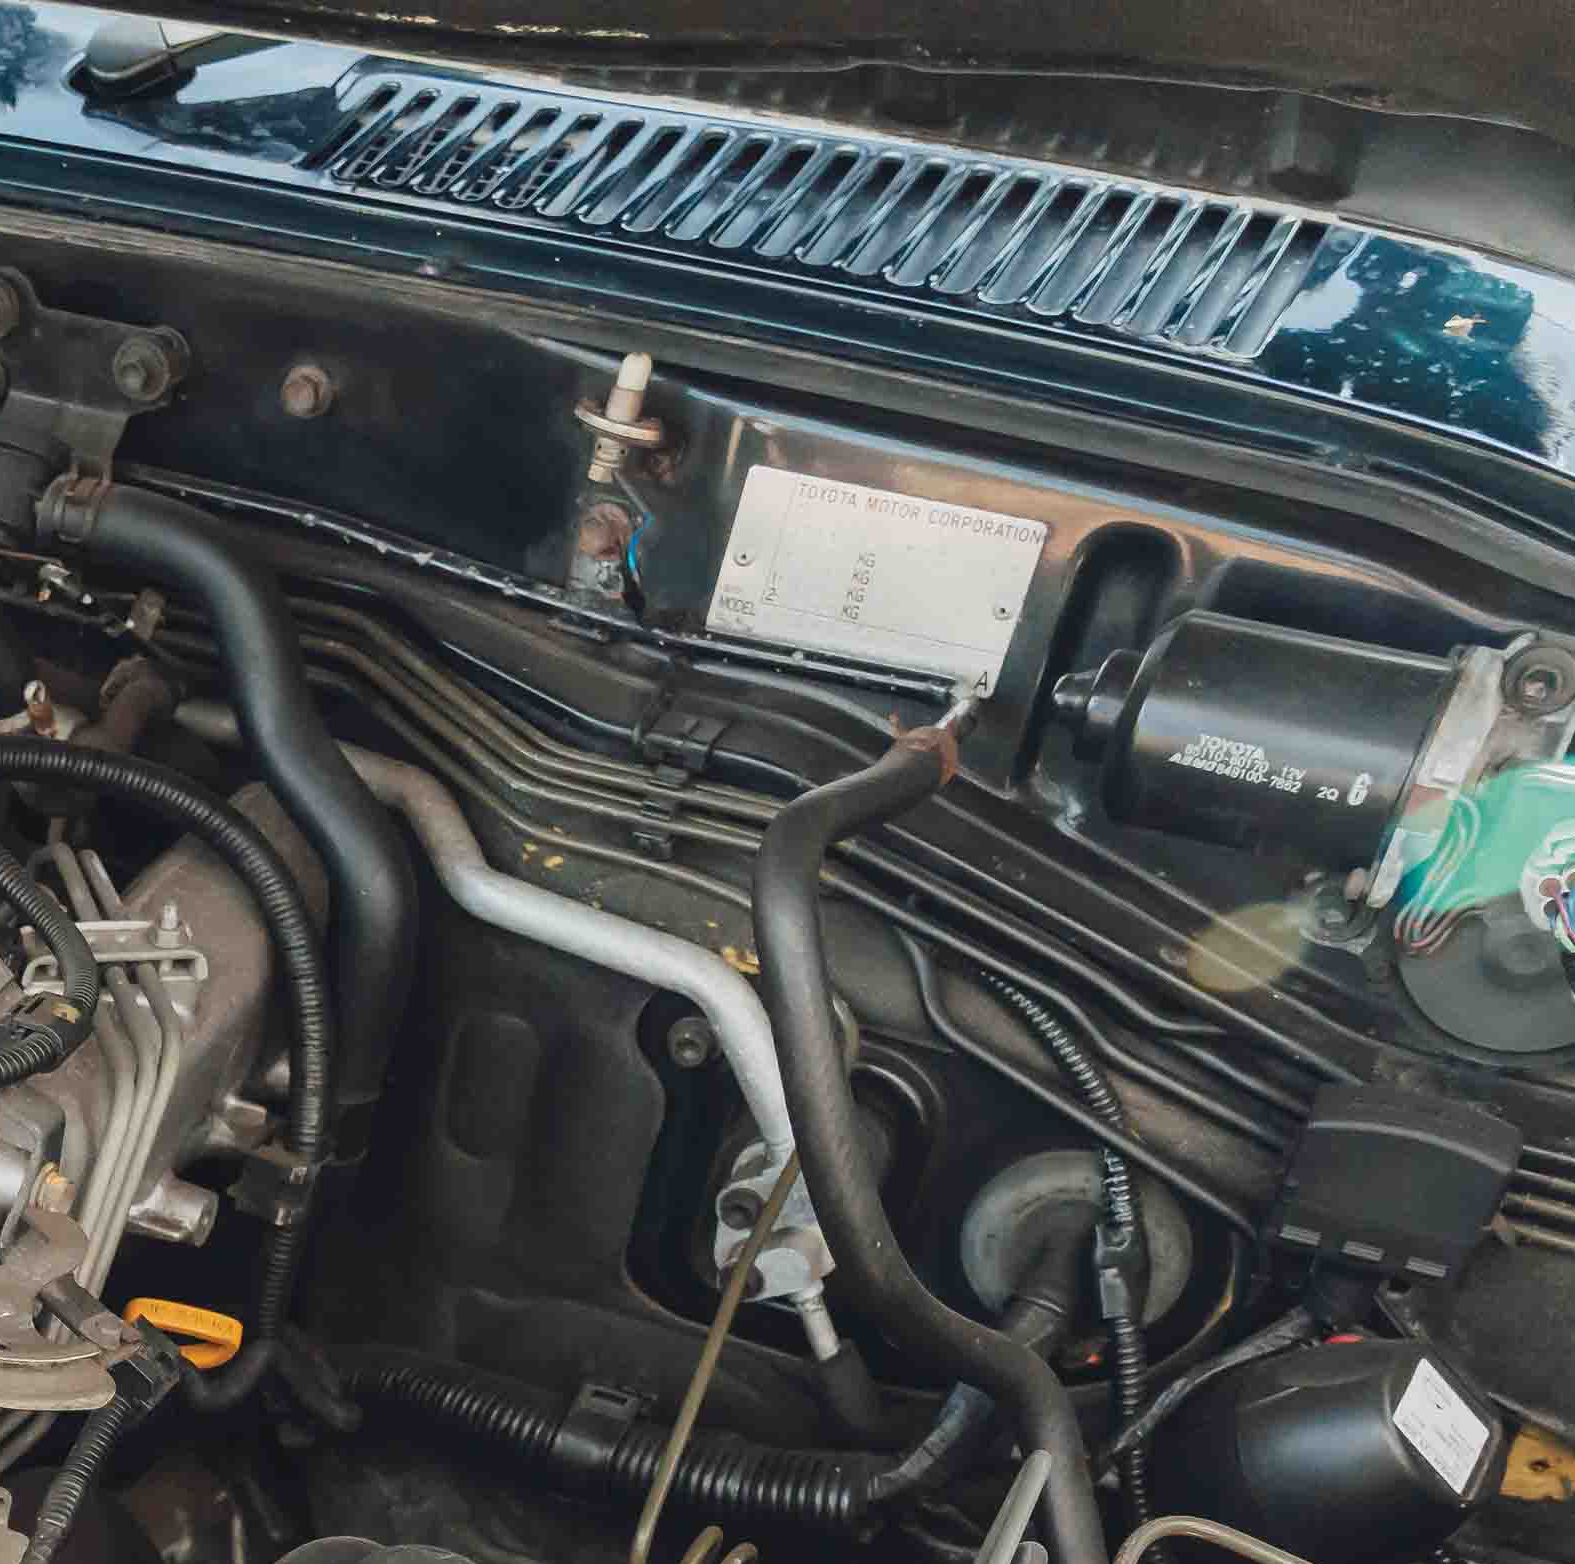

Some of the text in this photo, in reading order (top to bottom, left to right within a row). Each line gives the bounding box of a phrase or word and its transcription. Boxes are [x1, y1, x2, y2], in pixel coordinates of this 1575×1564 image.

[798, 483, 1044, 545] TOYOTA MOTOR CORPORATION
[719, 597, 756, 617] MODEL
[974, 671, 989, 691] A
[1200, 733, 1265, 760] TOYOTA
